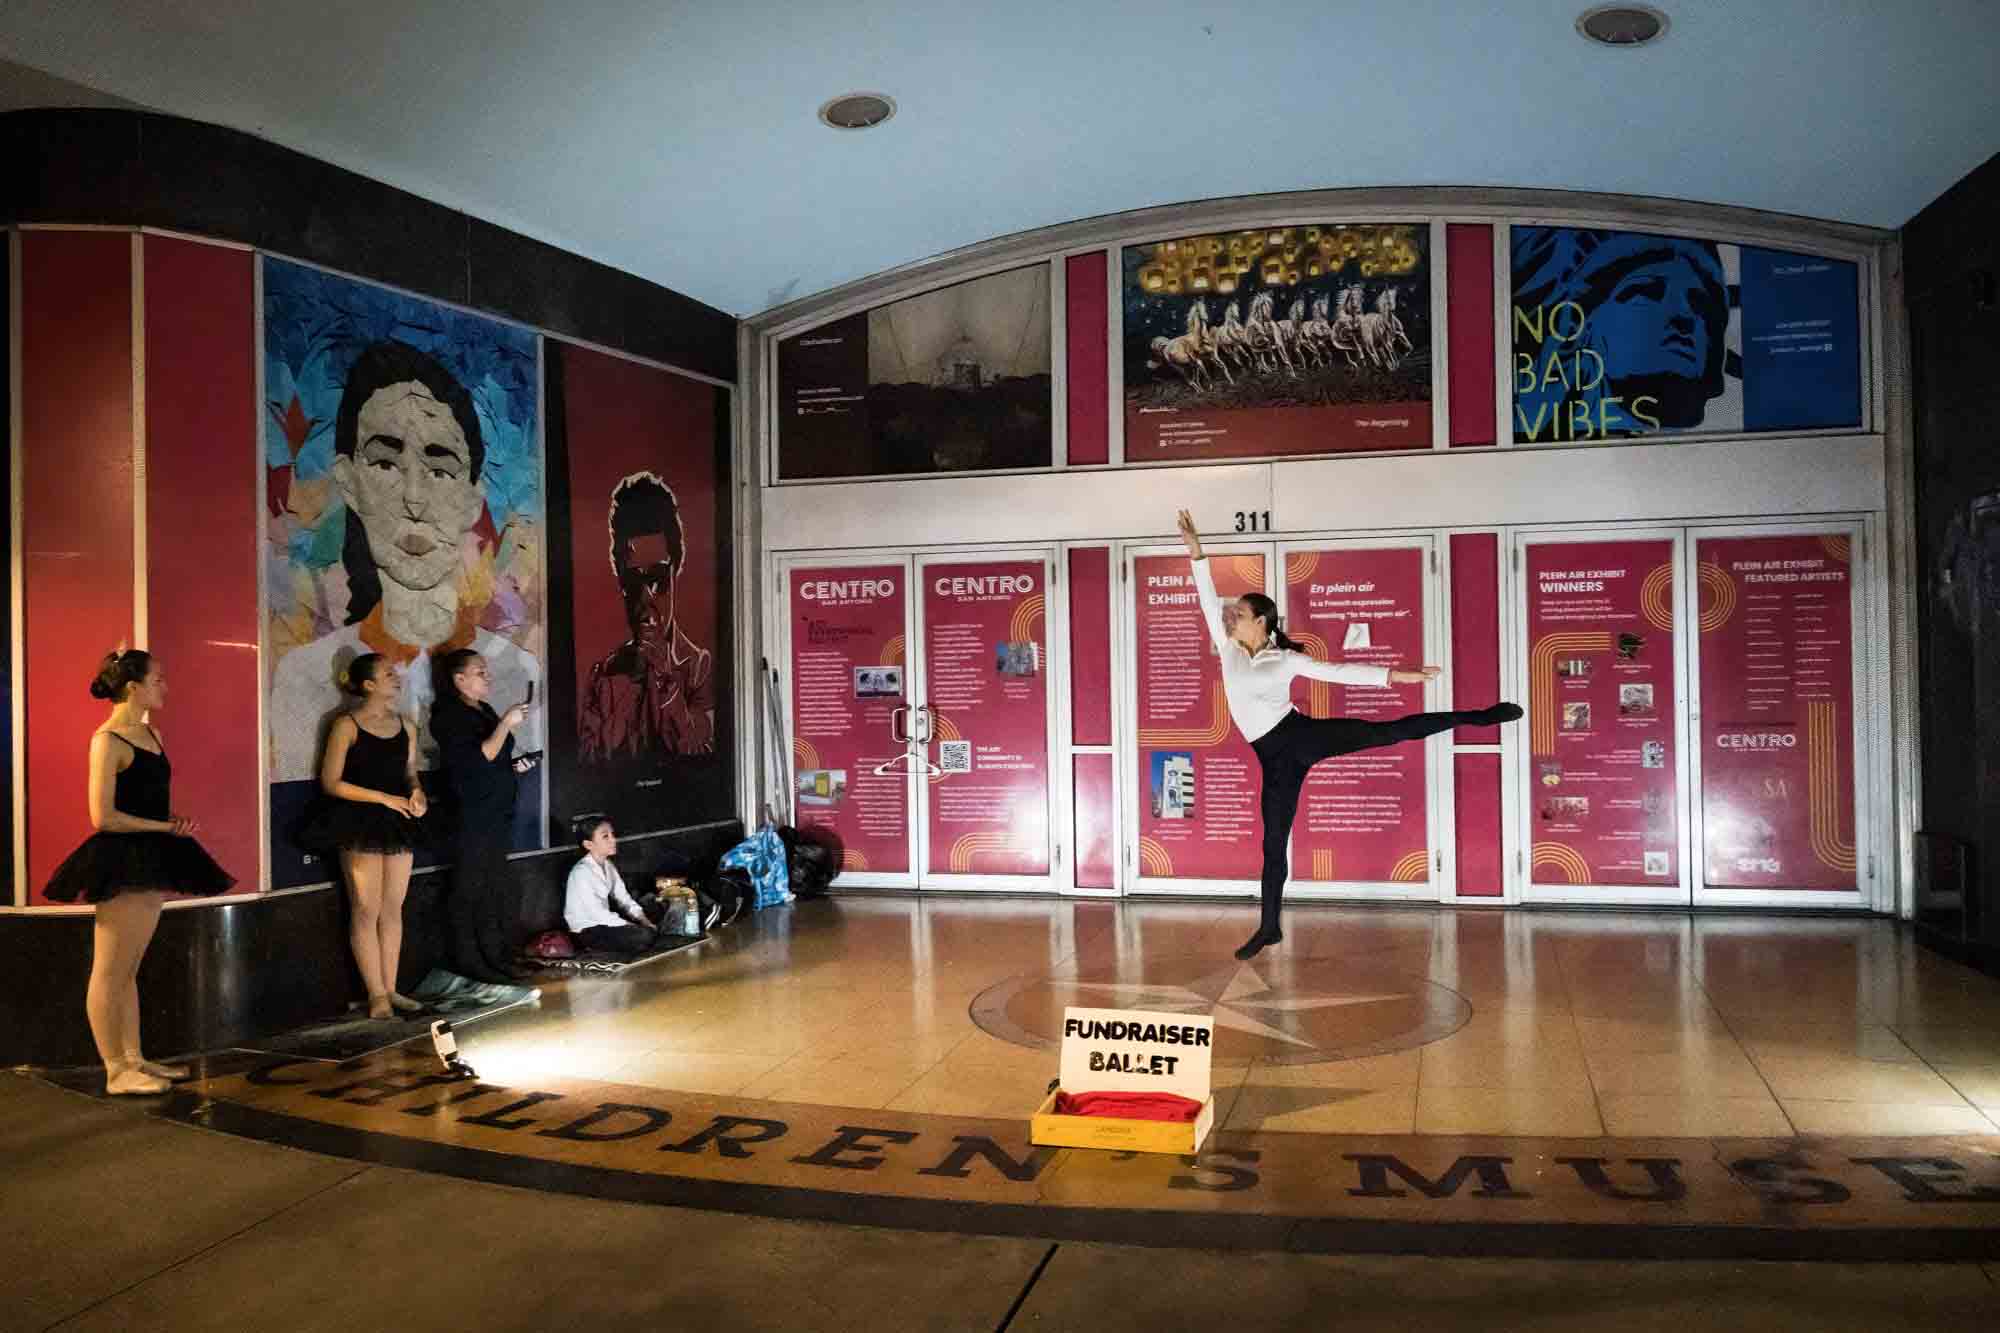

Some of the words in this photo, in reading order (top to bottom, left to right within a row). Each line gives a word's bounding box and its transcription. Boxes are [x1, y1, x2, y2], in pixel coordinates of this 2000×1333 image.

[1513, 300, 1586, 345] NO
[1513, 348, 1605, 394] BAD
[1516, 396, 1661, 443] VIBES
[1234, 511, 1272, 532] 311
[1147, 576, 1184, 587] PLEIN
[1539, 571, 1567, 580] PLEIN
[1568, 570, 1585, 579] AIR
[1744, 573, 1799, 583] FEATURED
[799, 579, 895, 601] CENTRO
[934, 575, 1034, 597] CENTRO
[1310, 584, 1324, 593] En
[1326, 583, 1356, 595] plein
[1358, 582, 1376, 592] air
[1539, 581, 1604, 593] WINNERS
[1716, 733, 1797, 748] CENTRO
[1064, 1018, 1210, 1047] FUNDRAISER
[1089, 1051, 1179, 1076] BALLET
